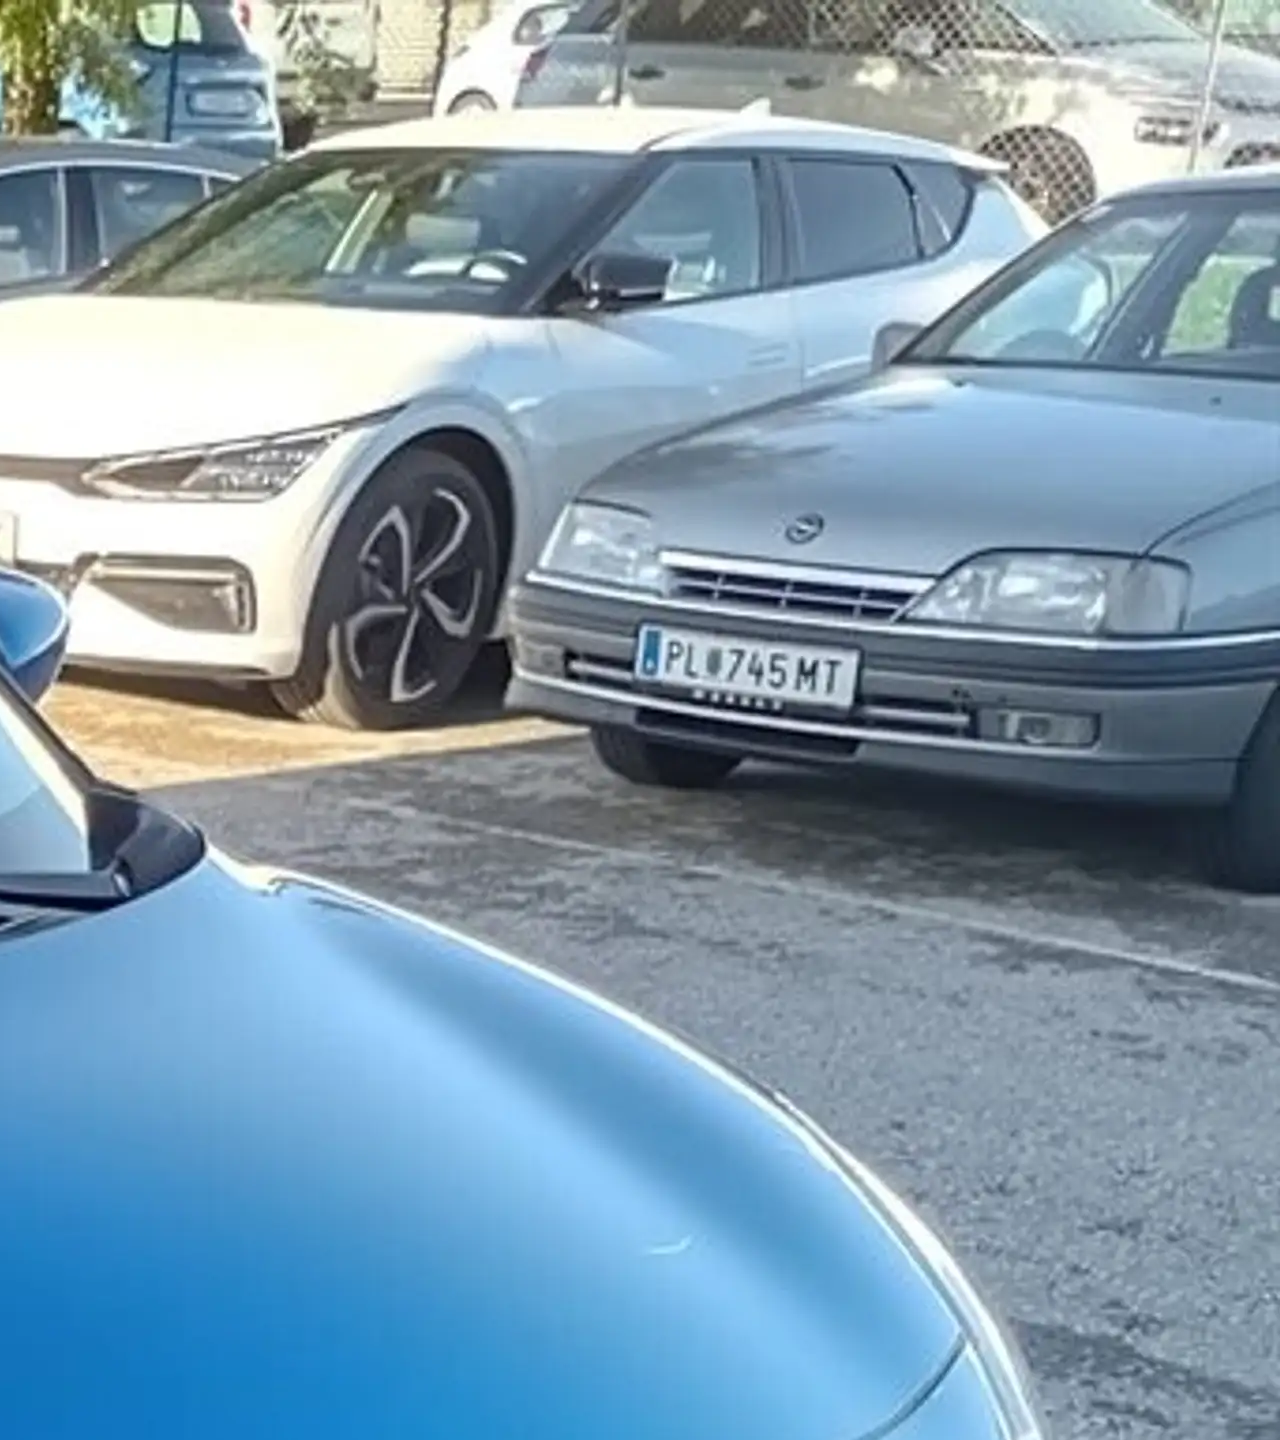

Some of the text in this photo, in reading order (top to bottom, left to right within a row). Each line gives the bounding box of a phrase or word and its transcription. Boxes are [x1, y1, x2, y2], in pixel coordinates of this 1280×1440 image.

[665, 640, 843, 696] PL 745 MT
